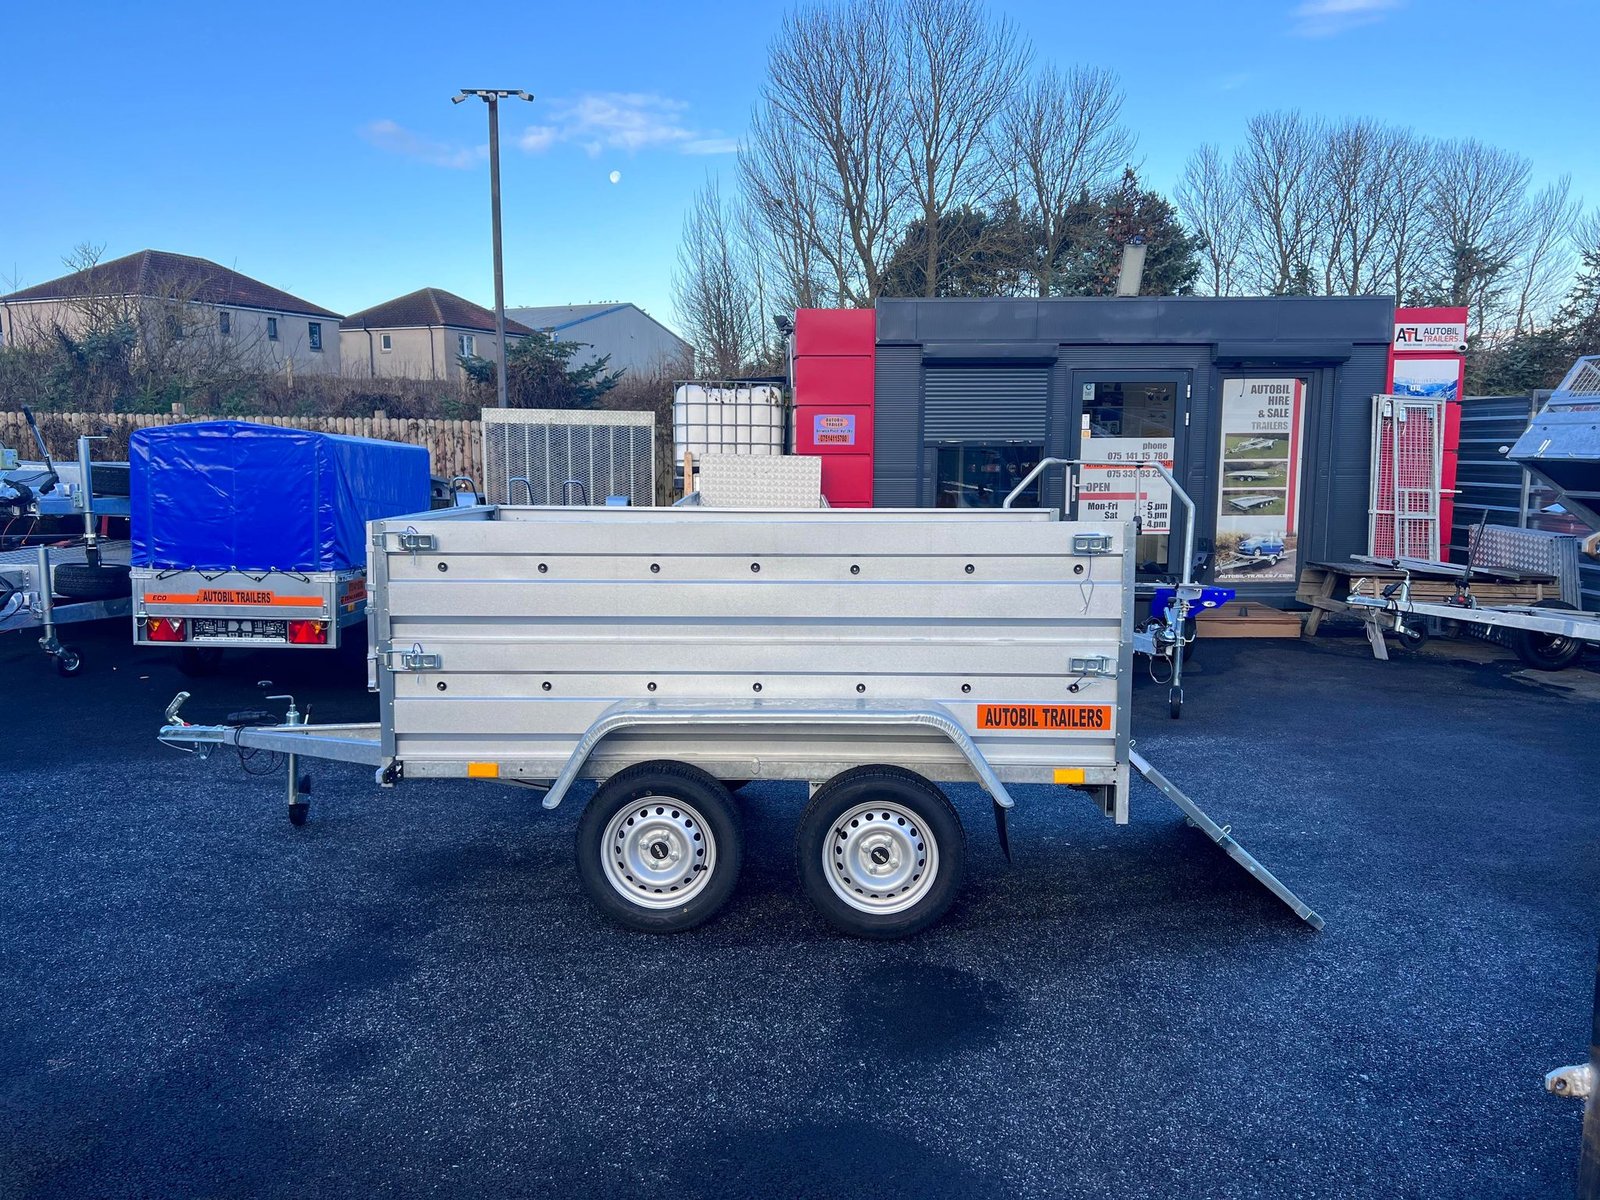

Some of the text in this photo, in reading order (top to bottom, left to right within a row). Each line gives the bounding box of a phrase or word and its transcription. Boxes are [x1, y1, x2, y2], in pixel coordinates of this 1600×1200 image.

[1424, 327, 1459, 335] AUTOBIL
[1251, 384, 1290, 394] AUTOBIL
[1268, 396, 1290, 405] HIRE
[1258, 408, 1289, 418] & SALE
[1252, 421, 1288, 430] TRAILERS
[1142, 442, 1168, 450] phone
[1086, 483, 1110, 492] OPEN
[1088, 502, 1118, 510] Mon-Fri
[203, 591, 270, 603] AUTOBIL TRAILERS
[985, 708, 1103, 728] AUTOBIL TRAILERS
